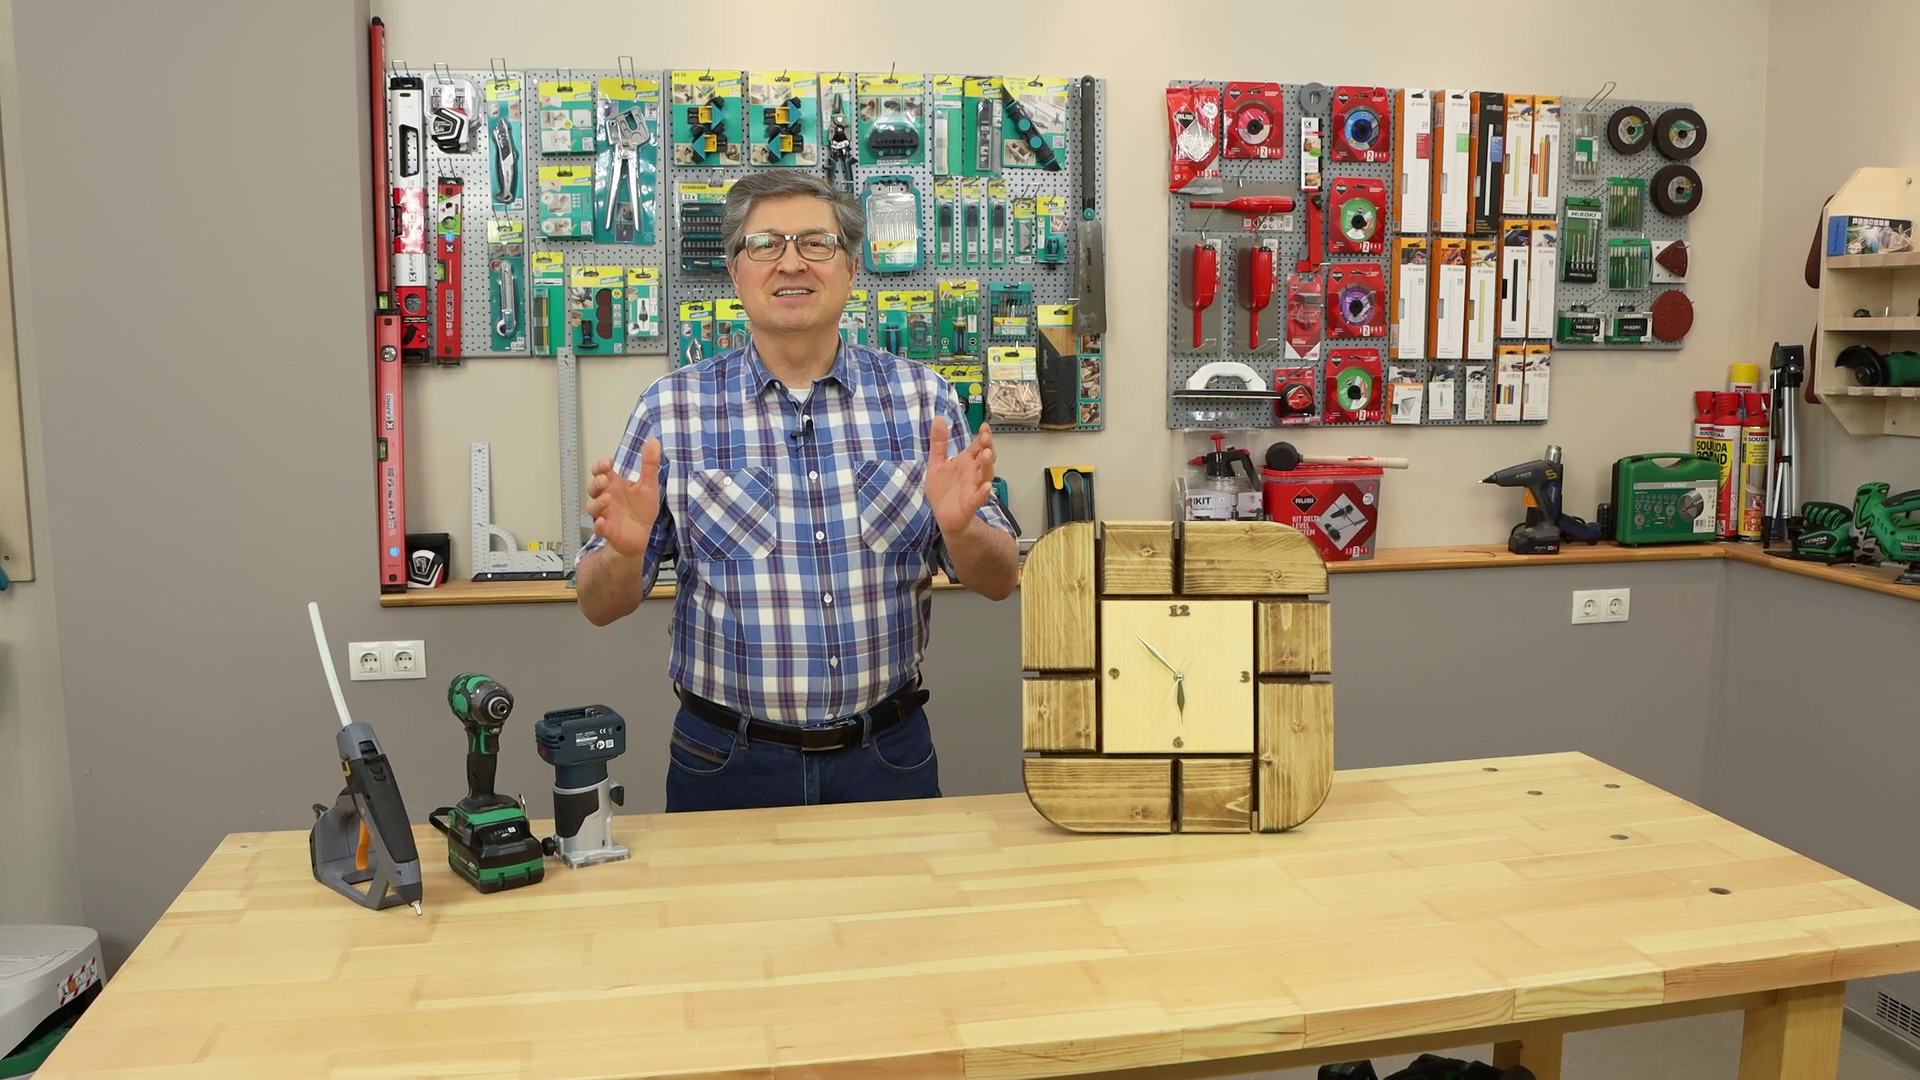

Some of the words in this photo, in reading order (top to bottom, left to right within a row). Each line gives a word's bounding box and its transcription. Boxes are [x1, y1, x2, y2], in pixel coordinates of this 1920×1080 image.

[1696, 441, 1713, 450] SOU
[1805, 536, 1827, 544] HITACHI
[1168, 604, 1190, 617] 12
[1108, 667, 1120, 680] 9
[1239, 671, 1250, 683] 3
[1172, 736, 1184, 749] 6
